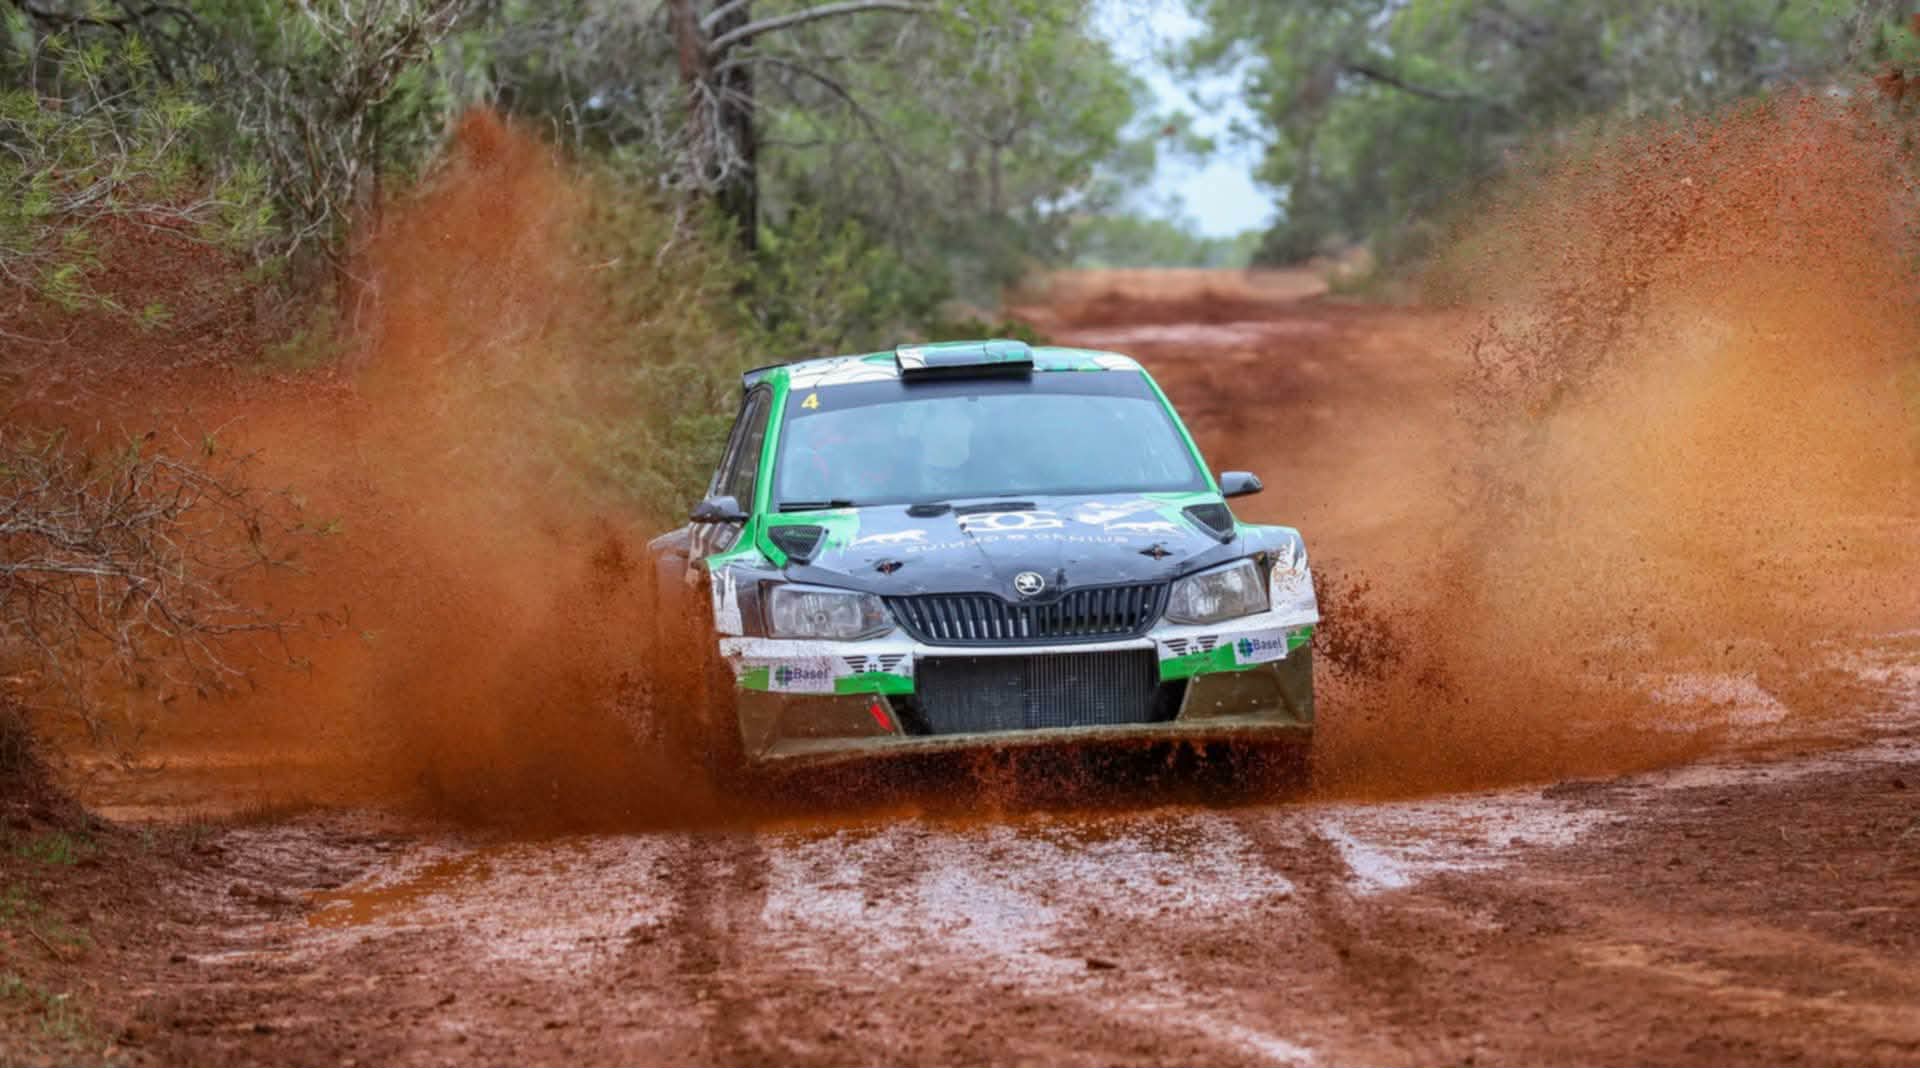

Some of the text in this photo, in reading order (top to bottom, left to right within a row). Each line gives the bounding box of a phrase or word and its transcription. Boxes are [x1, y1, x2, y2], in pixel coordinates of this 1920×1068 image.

[801, 393, 820, 410] 4
[1253, 637, 1282, 651] Basel
[793, 667, 830, 681] Basel
